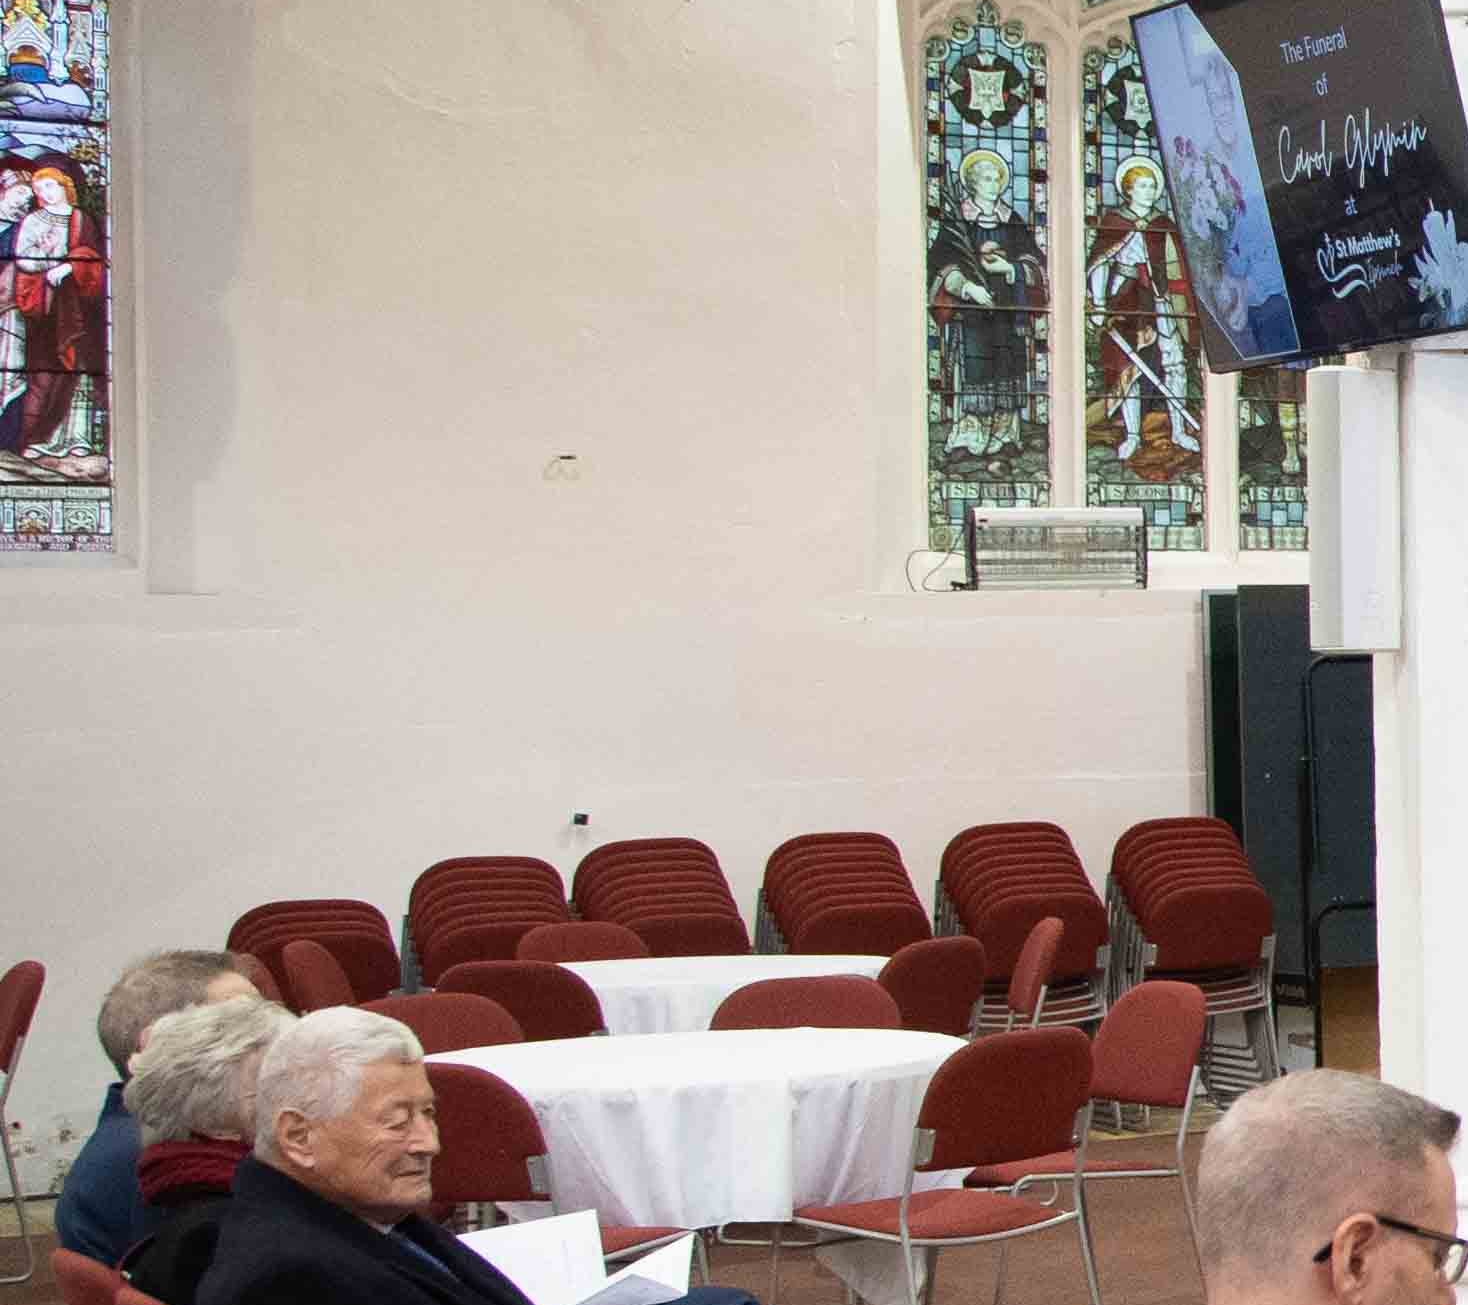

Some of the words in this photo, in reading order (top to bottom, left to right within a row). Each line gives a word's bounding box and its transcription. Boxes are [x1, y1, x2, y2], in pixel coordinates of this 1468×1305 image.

[1279, 40, 1304, 65] The
[1303, 24, 1349, 57] Funeral
[1316, 71, 1329, 96] of
[1345, 194, 1359, 216] at
[1335, 239, 1348, 258] St
[1346, 227, 1401, 258] Matthew's
